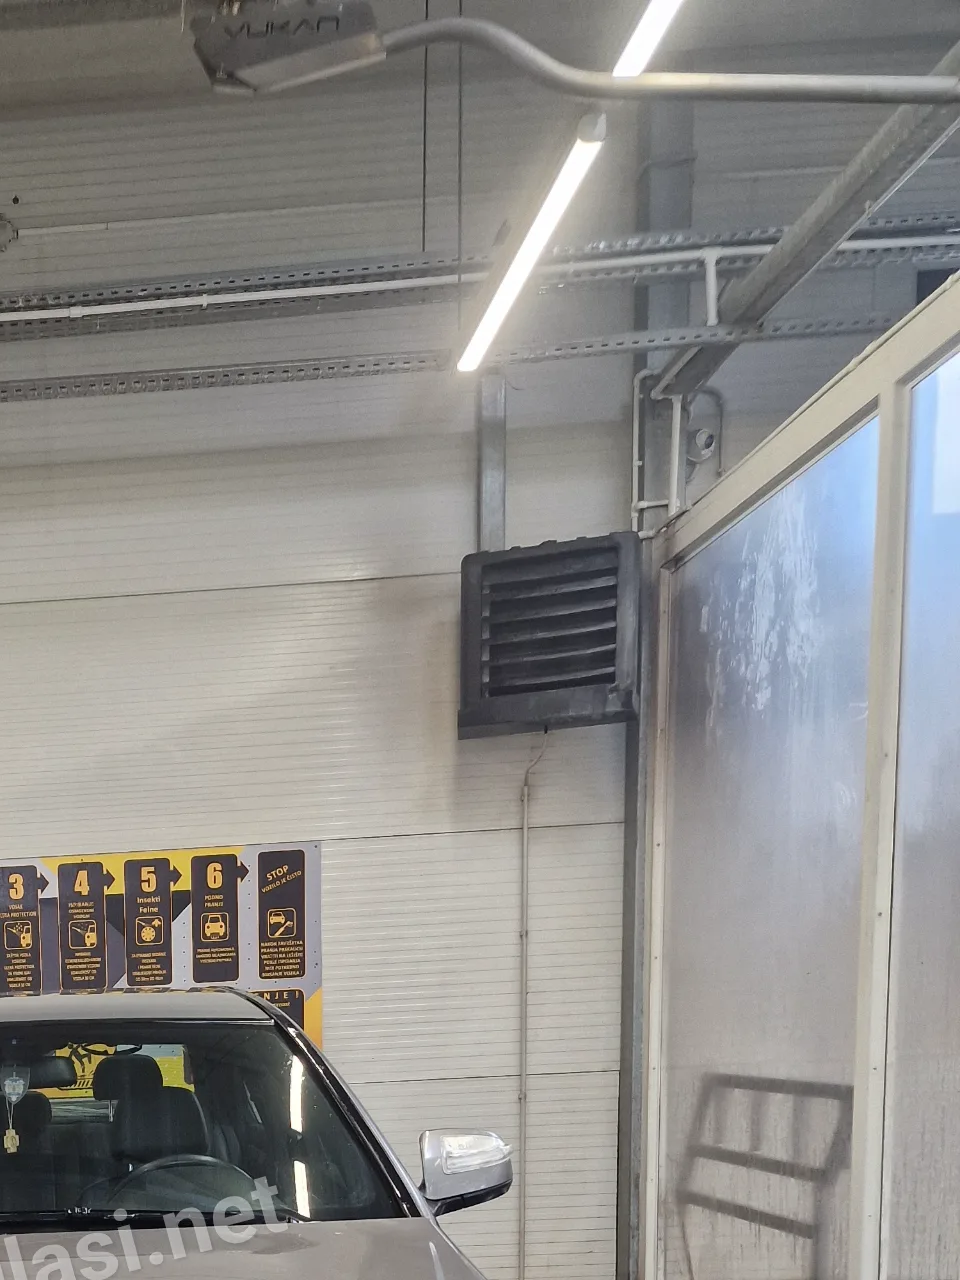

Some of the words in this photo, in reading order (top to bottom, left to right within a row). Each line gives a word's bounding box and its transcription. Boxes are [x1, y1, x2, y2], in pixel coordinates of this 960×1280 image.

[74, 870, 90, 896] 4
[140, 866, 157, 893] 5
[206, 862, 223, 889] 6
[266, 864, 289, 881] STOP
[8, 873, 25, 900] 3
[261, 880, 281, 893] VOZILO
[280, 877, 287, 885] JE
[136, 895, 161, 904] Insekti
[139, 906, 159, 914] Felne
